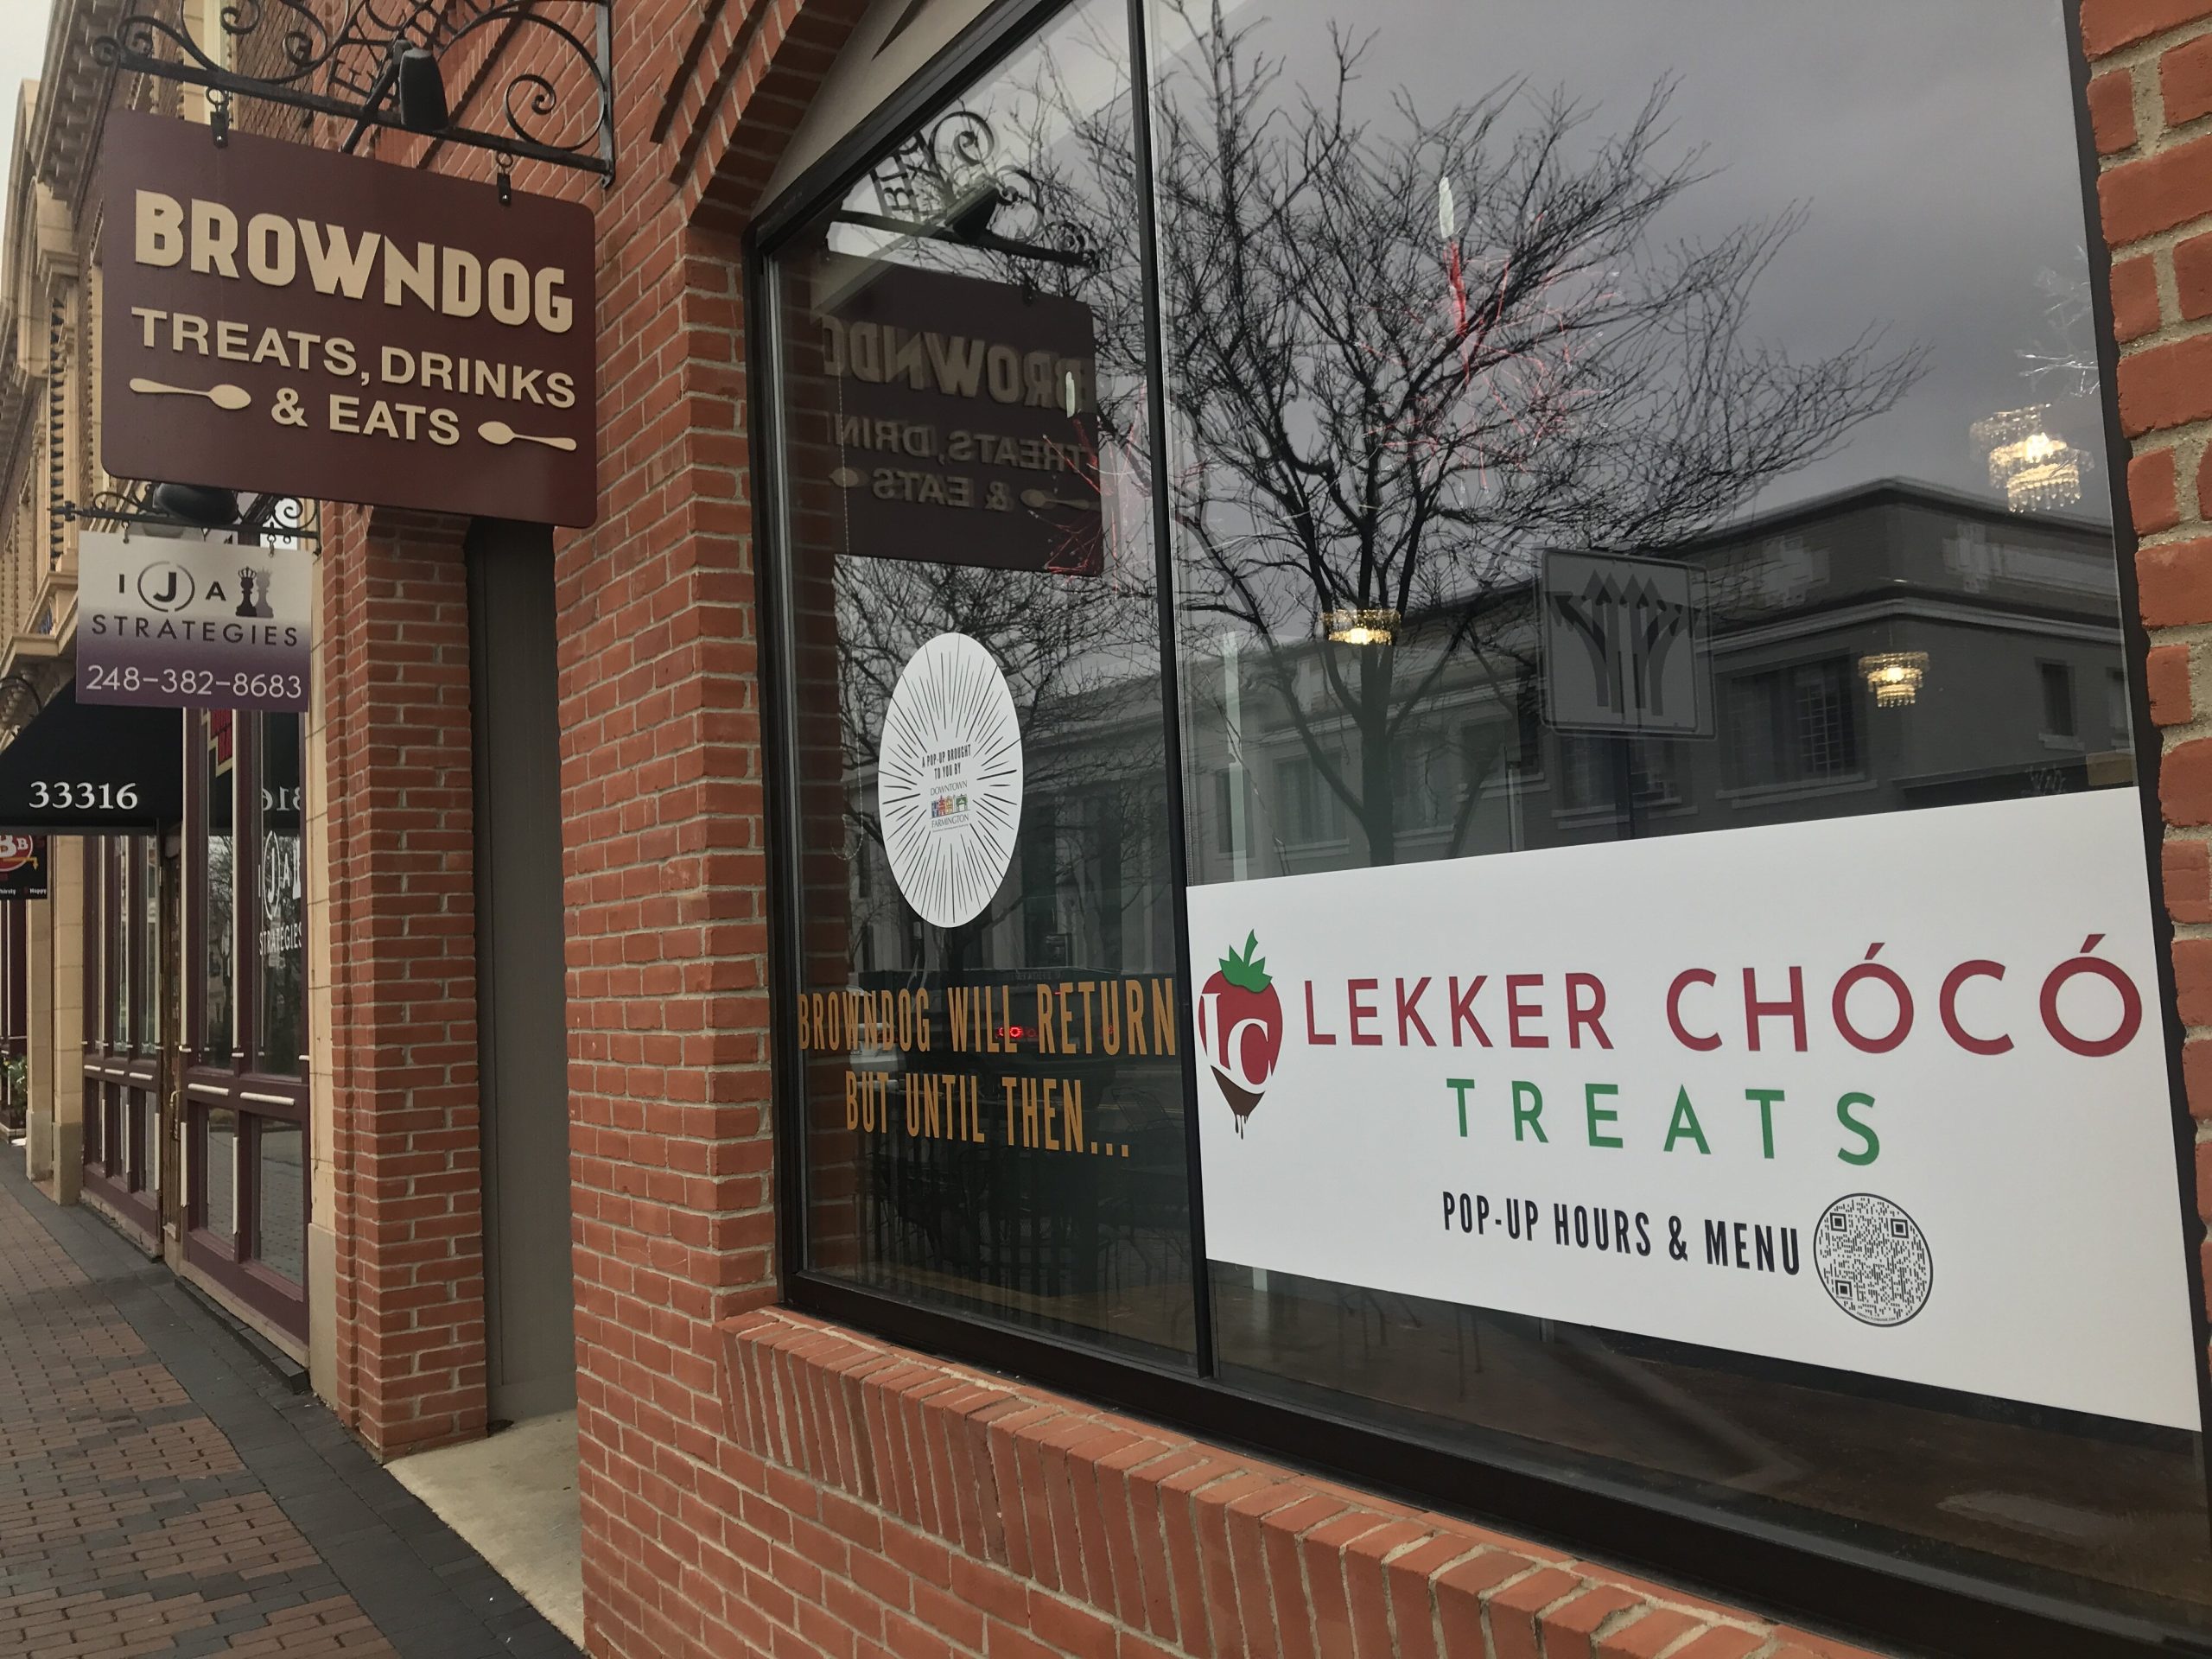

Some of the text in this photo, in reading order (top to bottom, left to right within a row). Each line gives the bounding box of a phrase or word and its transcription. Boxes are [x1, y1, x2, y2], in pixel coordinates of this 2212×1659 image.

[135, 189, 573, 334] BROWNDOG
[130, 307, 575, 409] TREATS, DRINKS
[270, 387, 460, 447] & EATS
[92, 613, 298, 647] STRATEGIES
[86, 664, 302, 699] 248-382-8683
[943, 764, 952, 778] YOU
[954, 762, 961, 775] BY
[947, 744, 970, 761] BROUGHT
[29, 781, 138, 810] 33316
[930, 780, 968, 796] DOWNTOWN
[931, 814, 969, 828] FARMINGTON
[798, 978, 1175, 1056] BROWNDOG WILL RETURN
[1305, 933, 2142, 1058] LEKKER CHÓCÓ
[845, 1071, 888, 1134] BUT
[906, 1072, 985, 1143] UNTIL
[1446, 1077, 1880, 1166] TREATS
[1442, 1191, 1801, 1276] POP-UP HOURS & MENU
